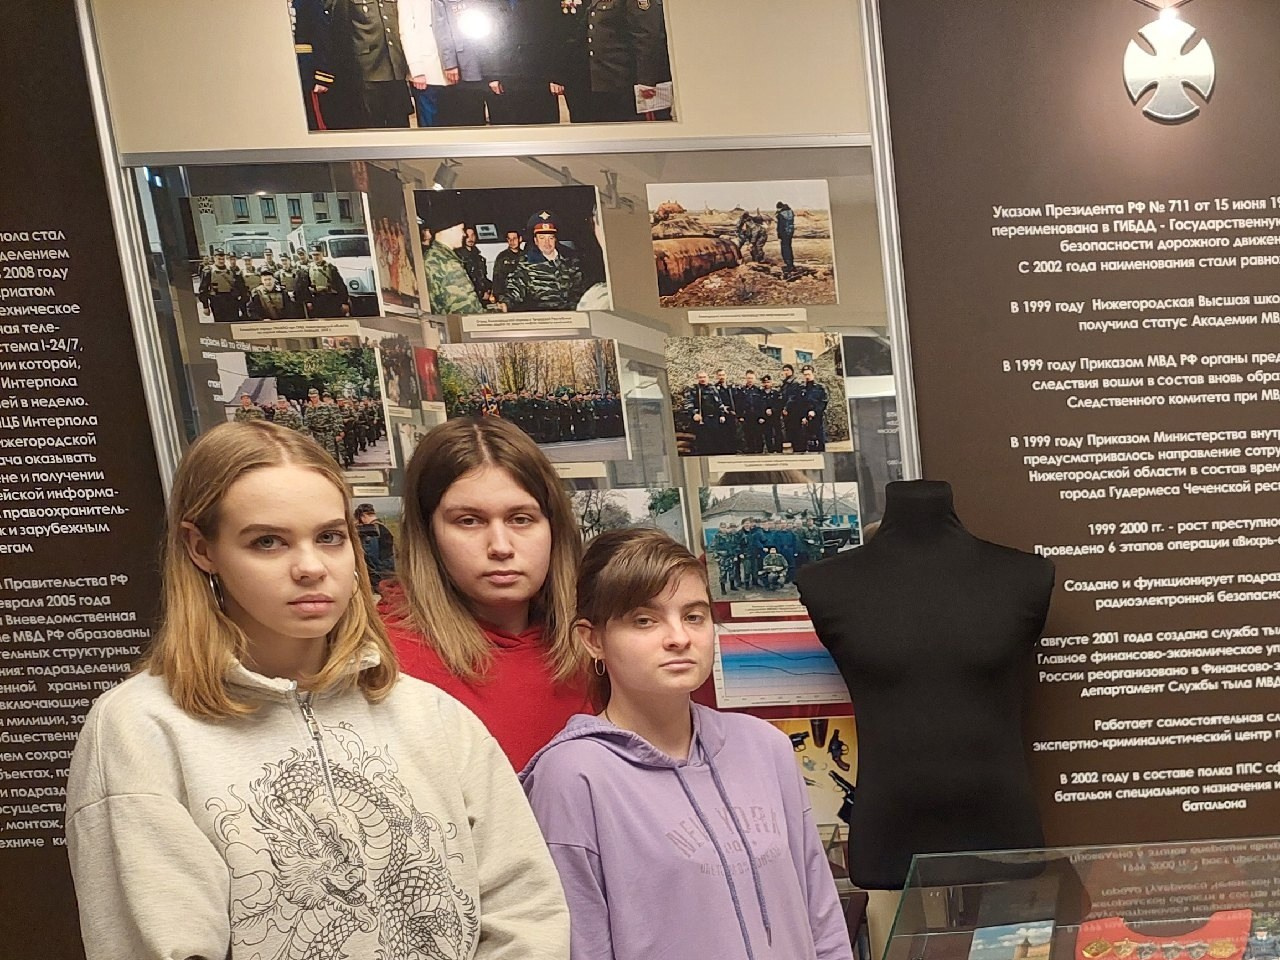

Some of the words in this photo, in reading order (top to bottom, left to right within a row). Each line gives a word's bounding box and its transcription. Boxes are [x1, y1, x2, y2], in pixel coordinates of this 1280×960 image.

[992, 205, 1043, 218] Указом
[1044, 203, 1125, 219] Президента
[1127, 201, 1146, 214] РФ
[1148, 200, 1166, 213] №
[1167, 199, 1190, 212] 711
[1193, 201, 1211, 211] от
[1213, 198, 1230, 211] 15
[1231, 199, 1267, 210] июня
[31, 230, 66, 241] стал
[1059, 239, 1154, 252] безопасности
[1156, 237, 1230, 251] дорожного
[1017, 260, 1030, 273] С
[1032, 260, 1063, 273] 2002
[1065, 261, 1097, 272] года
[1099, 258, 1195, 271] наименования
[1198, 256, 1237, 267] стали
[2, 265, 35, 279] 2008
[36, 267, 69, 280] году
[1009, 301, 1020, 313] В
[1022, 300, 1052, 313] 1999
[1054, 301, 1085, 313] году
[1091, 297, 1195, 312] Нижегородская
[1197, 295, 1251, 307] Высшая
[1077, 319, 1139, 333] получила
[1141, 317, 1188, 329] статус
[1190, 314, 1258, 327] Академии
[0, 376, 78, 390] Интерпола
[19, 398, 29, 407] в
[21, 415, 98, 429] Интерпола
[1009, 436, 1020, 448] В
[1022, 435, 1051, 447] 1999
[1054, 436, 1084, 449] году
[1086, 433, 1151, 448] Приказом
[1152, 430, 1247, 443] Министерства
[24, 453, 97, 464] оказывать
[19, 473, 30, 482] и
[31, 470, 105, 484] получении
[1059, 488, 1107, 501] города
[1108, 485, 1181, 499] Гудермеса
[1182, 479, 1252, 494] Чеченской
[7, 526, 18, 535] и
[18, 522, 111, 537] зарубежным
[1033, 544, 1105, 558] Проведено
[1107, 541, 1117, 553] 6
[1118, 541, 1164, 552] этапов
[1166, 538, 1230, 552] операции
[3, 576, 108, 591] Правительства
[109, 573, 129, 586] РФ
[1063, 579, 1120, 592] Создано
[1121, 579, 1131, 589] и
[1133, 574, 1235, 591] функционирует
[45, 594, 77, 607] 2005
[78, 595, 111, 606] года
[1094, 591, 1215, 611] радиоэлектронной
[4, 611, 137, 625] Вневедомственная
[12, 630, 46, 643] МВД
[45, 629, 65, 641] РФ
[66, 627, 151, 642] образованы
[51, 645, 142, 659] структурных
[26, 662, 133, 677] подразделения
[1079, 683, 1166, 698] департамент
[1167, 678, 1219, 694] Службы
[1220, 679, 1253, 689] тыла
[1059, 773, 1068, 784] В
[1070, 771, 1099, 784] 2002
[1101, 772, 1130, 783] году
[1132, 771, 1140, 781] в
[1142, 768, 1195, 780] составе
[1197, 766, 1233, 777] полка
[1235, 762, 1263, 775] ППС
